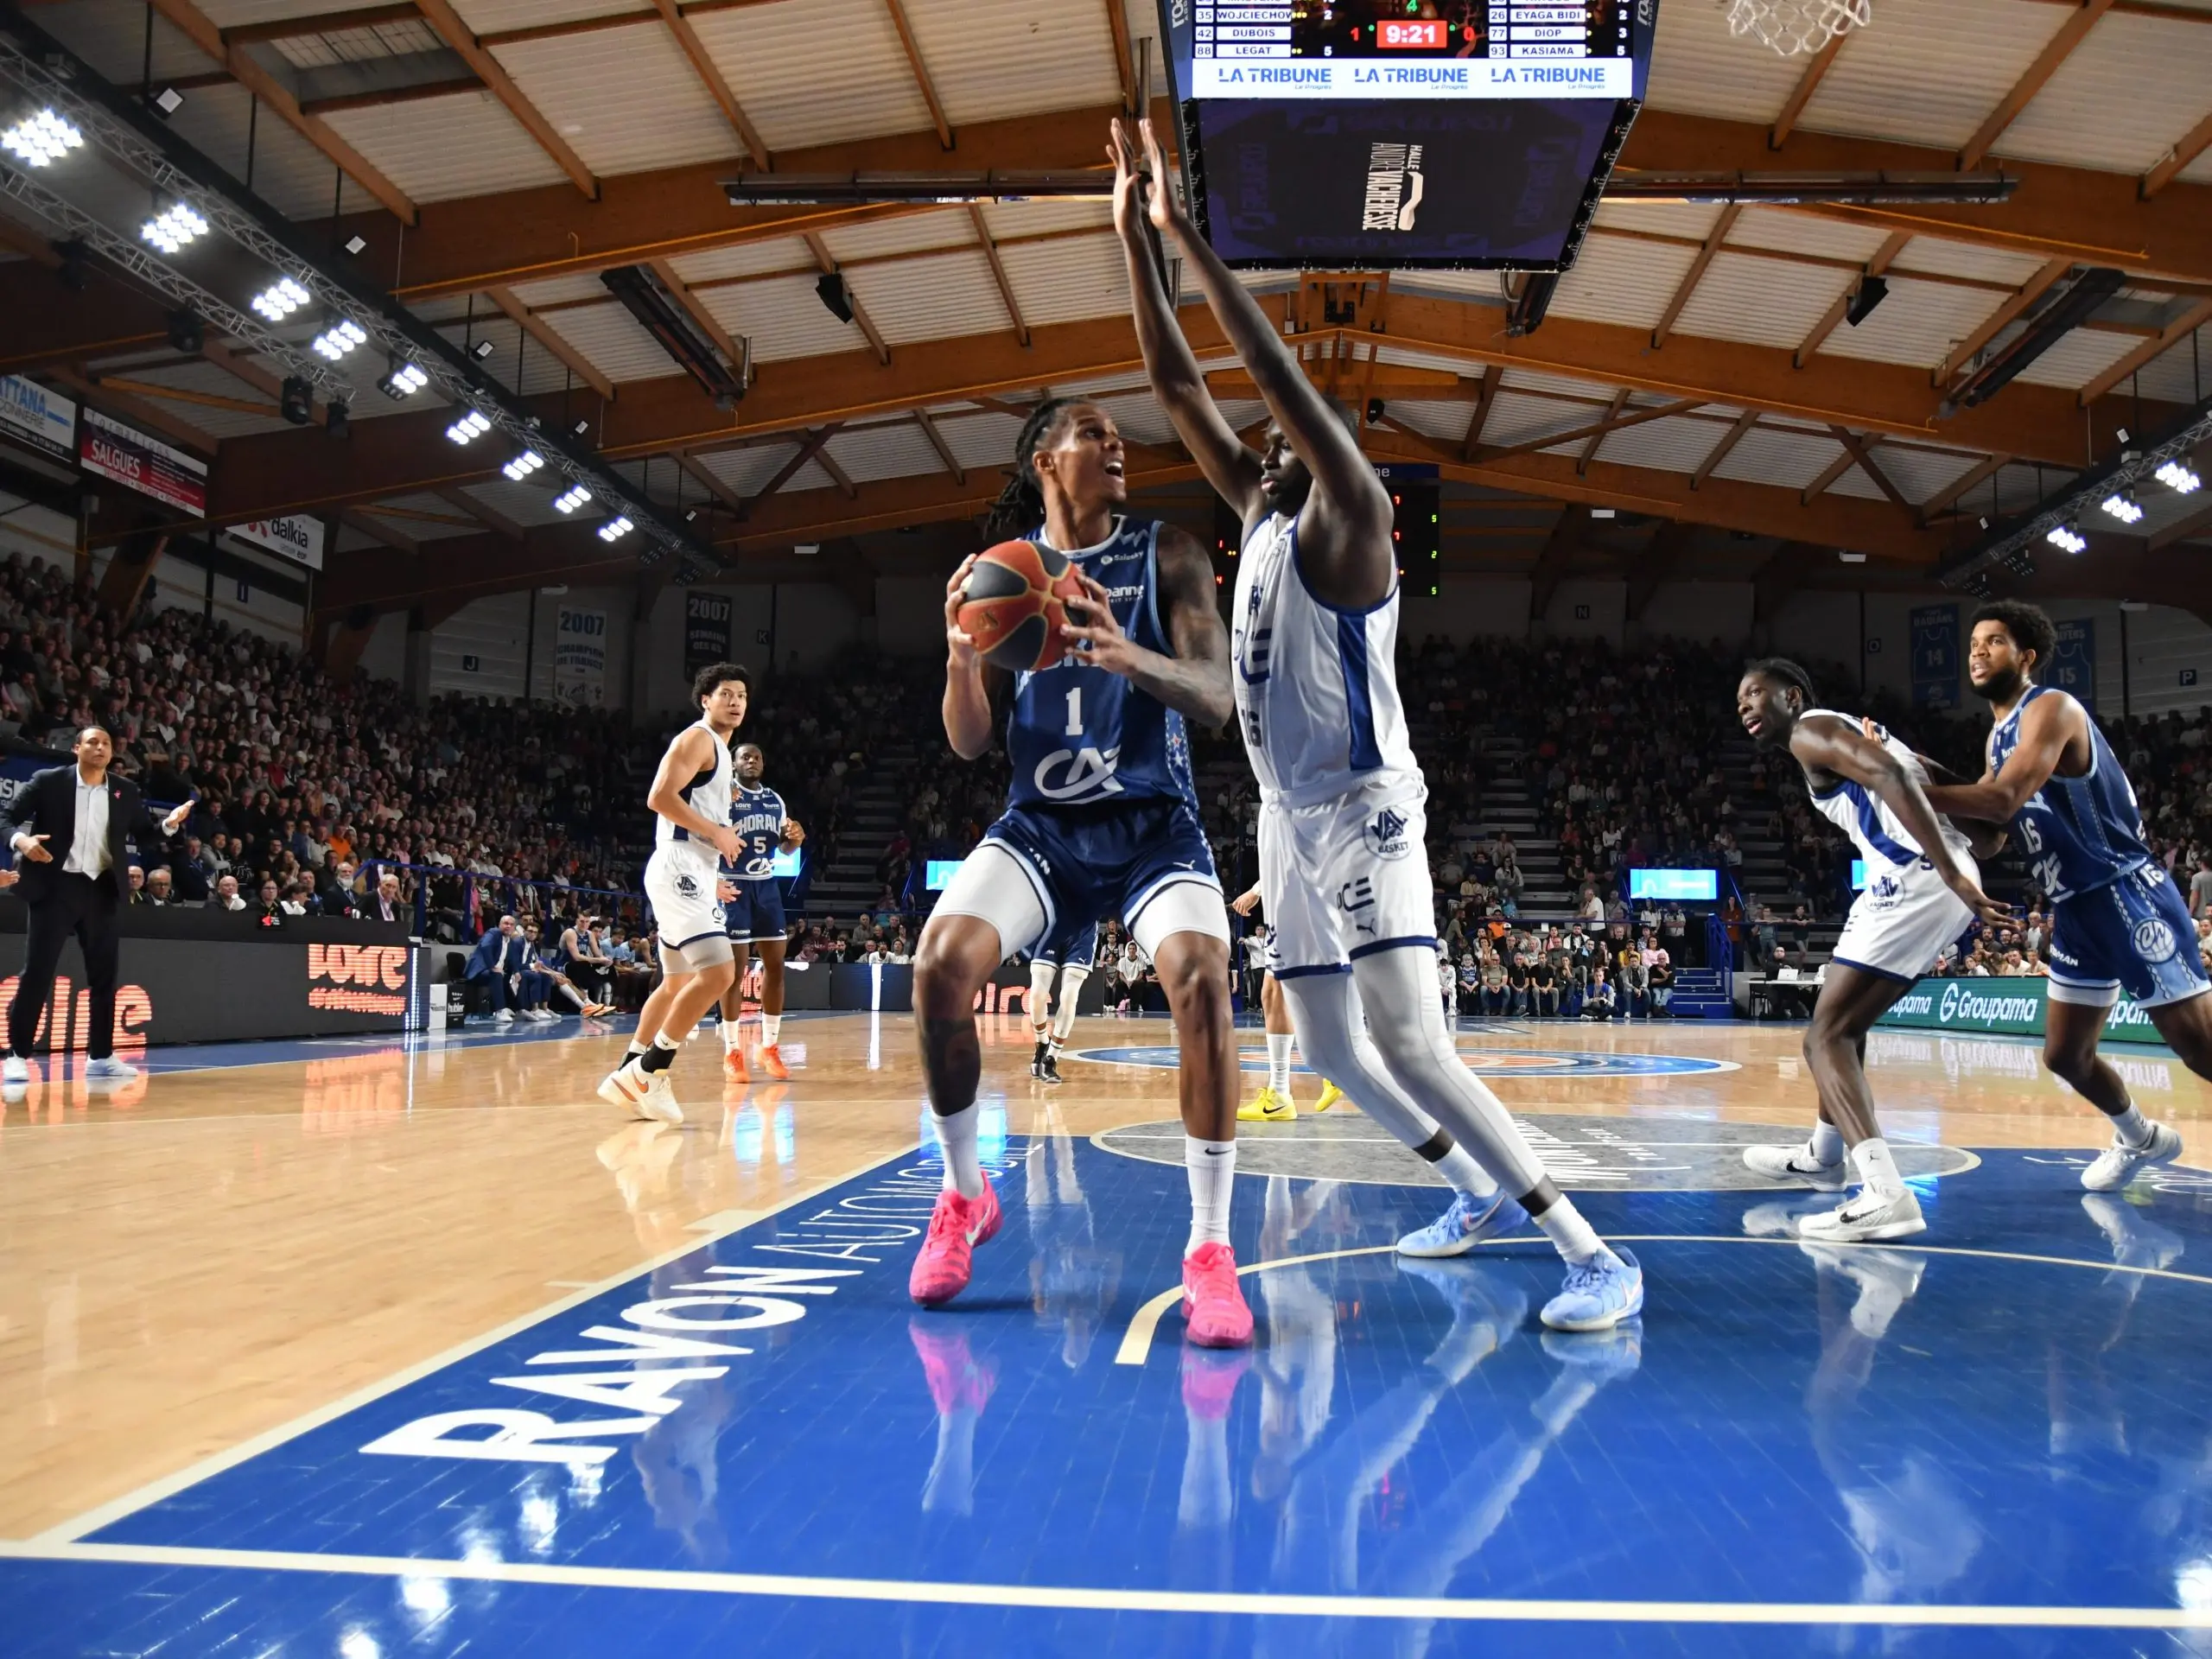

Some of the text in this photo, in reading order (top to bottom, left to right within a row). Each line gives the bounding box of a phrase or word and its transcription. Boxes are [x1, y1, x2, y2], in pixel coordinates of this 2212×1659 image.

[1198, 11, 1211, 20] 35
[1324, 10, 1332, 20] 2
[1491, 10, 1627, 20] 26 EYAGA BIDI 2
[1351, 24, 1475, 43] 1 9:21 0
[1618, 28, 1627, 38] 3
[1197, 47, 1211, 55] 88
[1324, 47, 1332, 56] 5
[1491, 46, 1625, 56] 93 KASIAMA 5
[1218, 68, 1332, 82] LA TRIBUNE
[1355, 68, 1468, 82] LA TRIBUNE
[1491, 68, 1605, 82] LA TRIBUNE
[1407, 144, 1422, 169] HALLE
[1362, 142, 1407, 230] ANDRÉ VACHERESSE
[91, 439, 141, 479] SALGUES
[271, 517, 308, 549] dalkia
[688, 598, 730, 621] 2007
[1577, 606, 1588, 618] N
[560, 611, 604, 635] 2007
[758, 631, 767, 644] K
[557, 644, 604, 658] CHAMPION
[467, 657, 476, 670] J
[556, 656, 567, 665] DE
[570, 656, 603, 671] FRANCE
[2057, 666, 2076, 685] 15
[2183, 671, 2194, 684] P
[1065, 687, 1084, 736] 1
[734, 814, 781, 837] HORAL
[2018, 817, 2043, 855] 16
[753, 836, 766, 855] 5
[1378, 842, 1408, 853] BASKET
[2139, 863, 2164, 887] 16
[1958, 990, 2038, 1027] Groupama
[359, 1266, 863, 1465] RAVON
